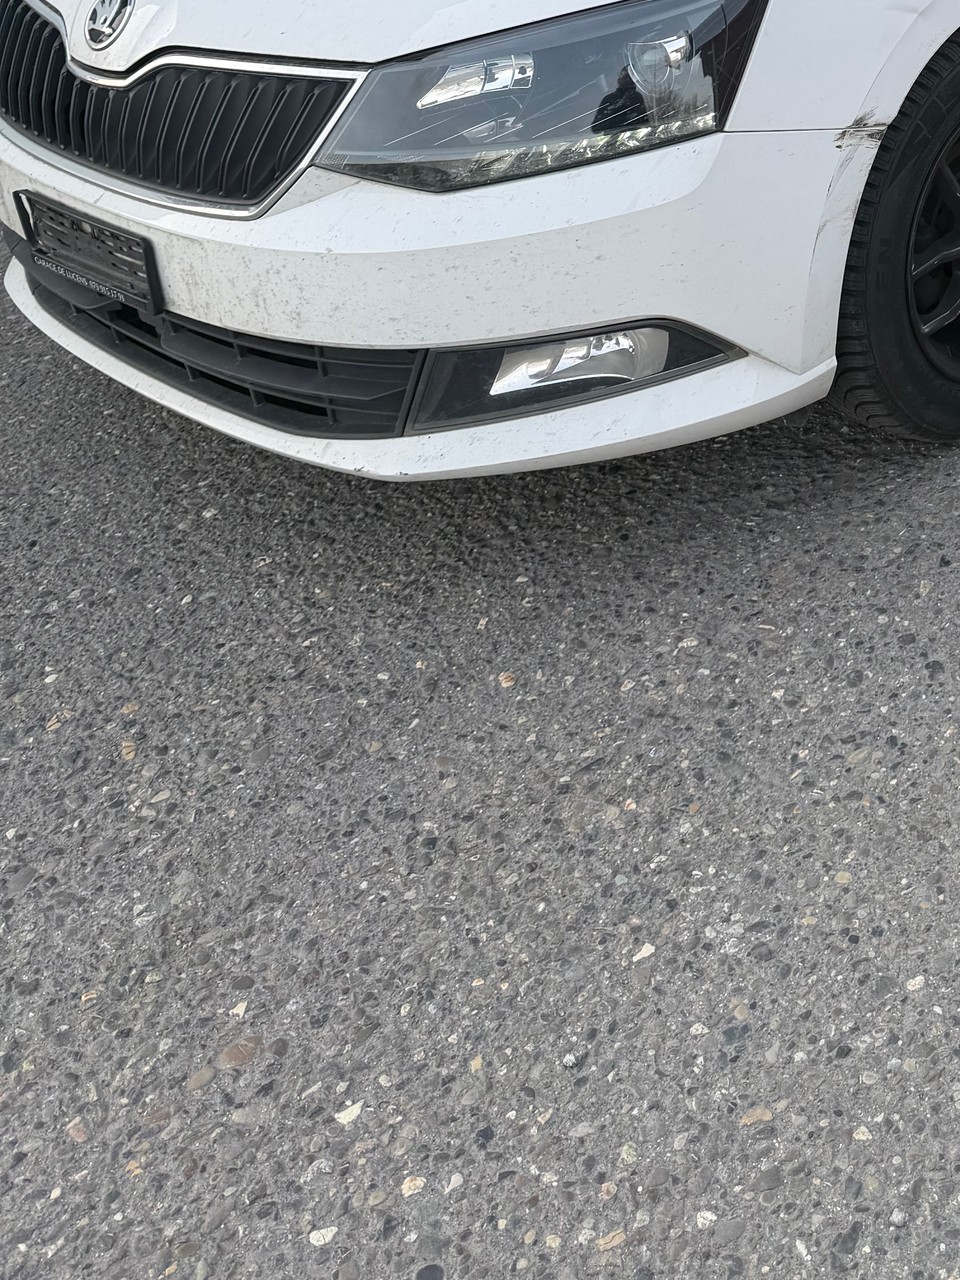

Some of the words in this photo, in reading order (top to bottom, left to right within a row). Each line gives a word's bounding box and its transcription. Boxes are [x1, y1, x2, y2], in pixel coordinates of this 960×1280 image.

[34, 257, 58, 273] GARAGE
[57, 267, 66, 276] DE
[65, 270, 88, 286] LUCENS
